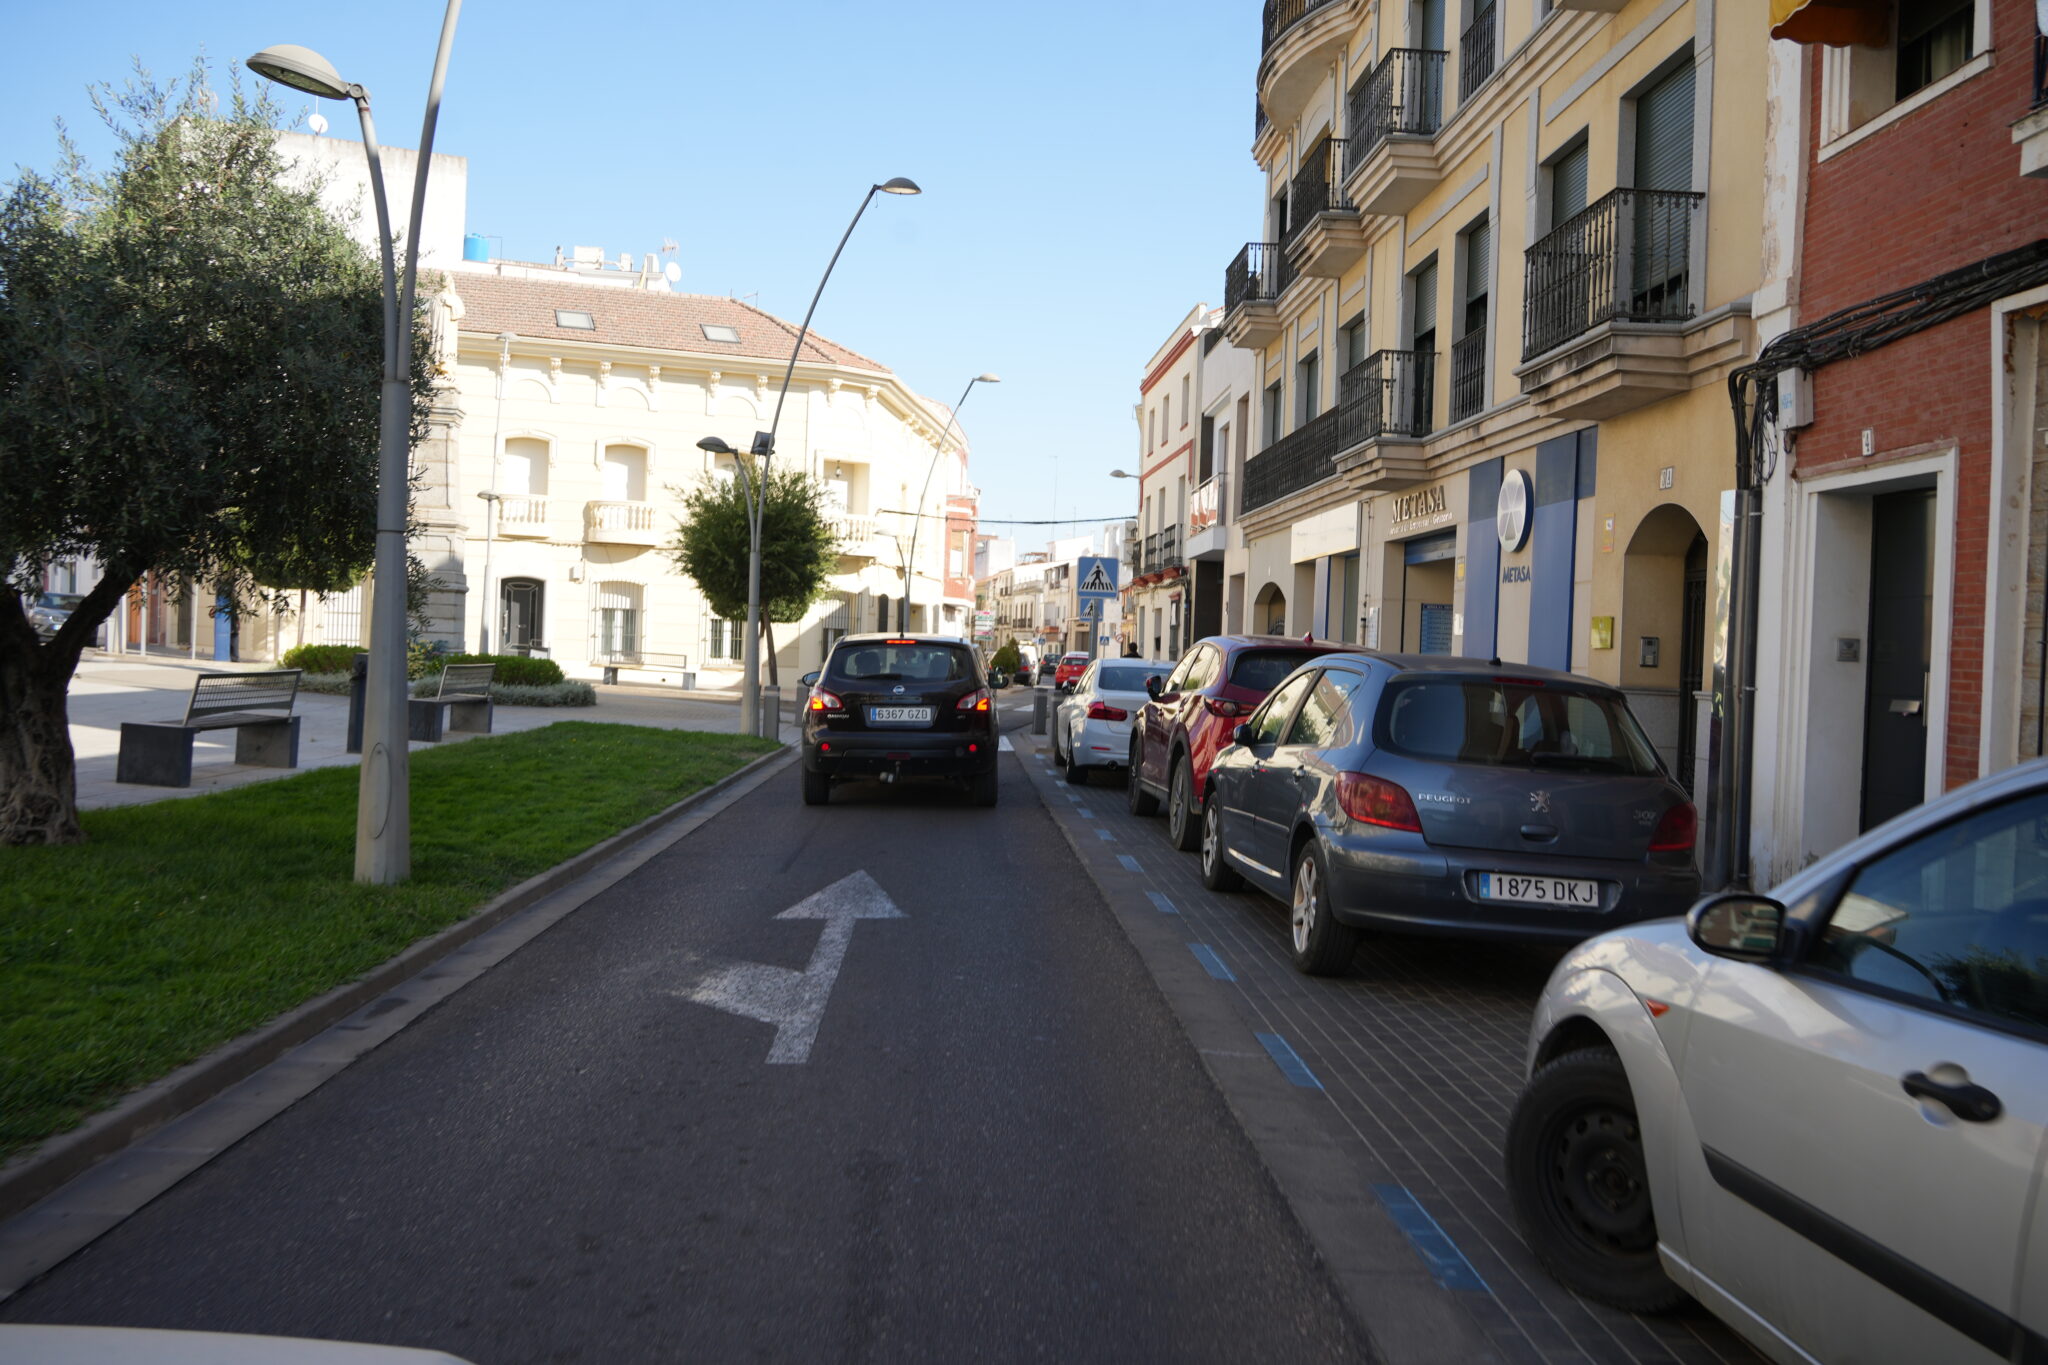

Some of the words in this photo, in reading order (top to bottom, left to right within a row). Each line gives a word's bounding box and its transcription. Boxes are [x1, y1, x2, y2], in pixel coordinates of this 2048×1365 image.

[1391, 485, 1447, 524] METASA
[1502, 566, 1531, 584] METASA
[877, 709, 904, 720] 6367
[907, 709, 928, 720] GZD
[1418, 793, 1472, 804] PEUGEOT
[1496, 876, 1546, 899] 1875
[1553, 881, 1594, 903] DKJ
